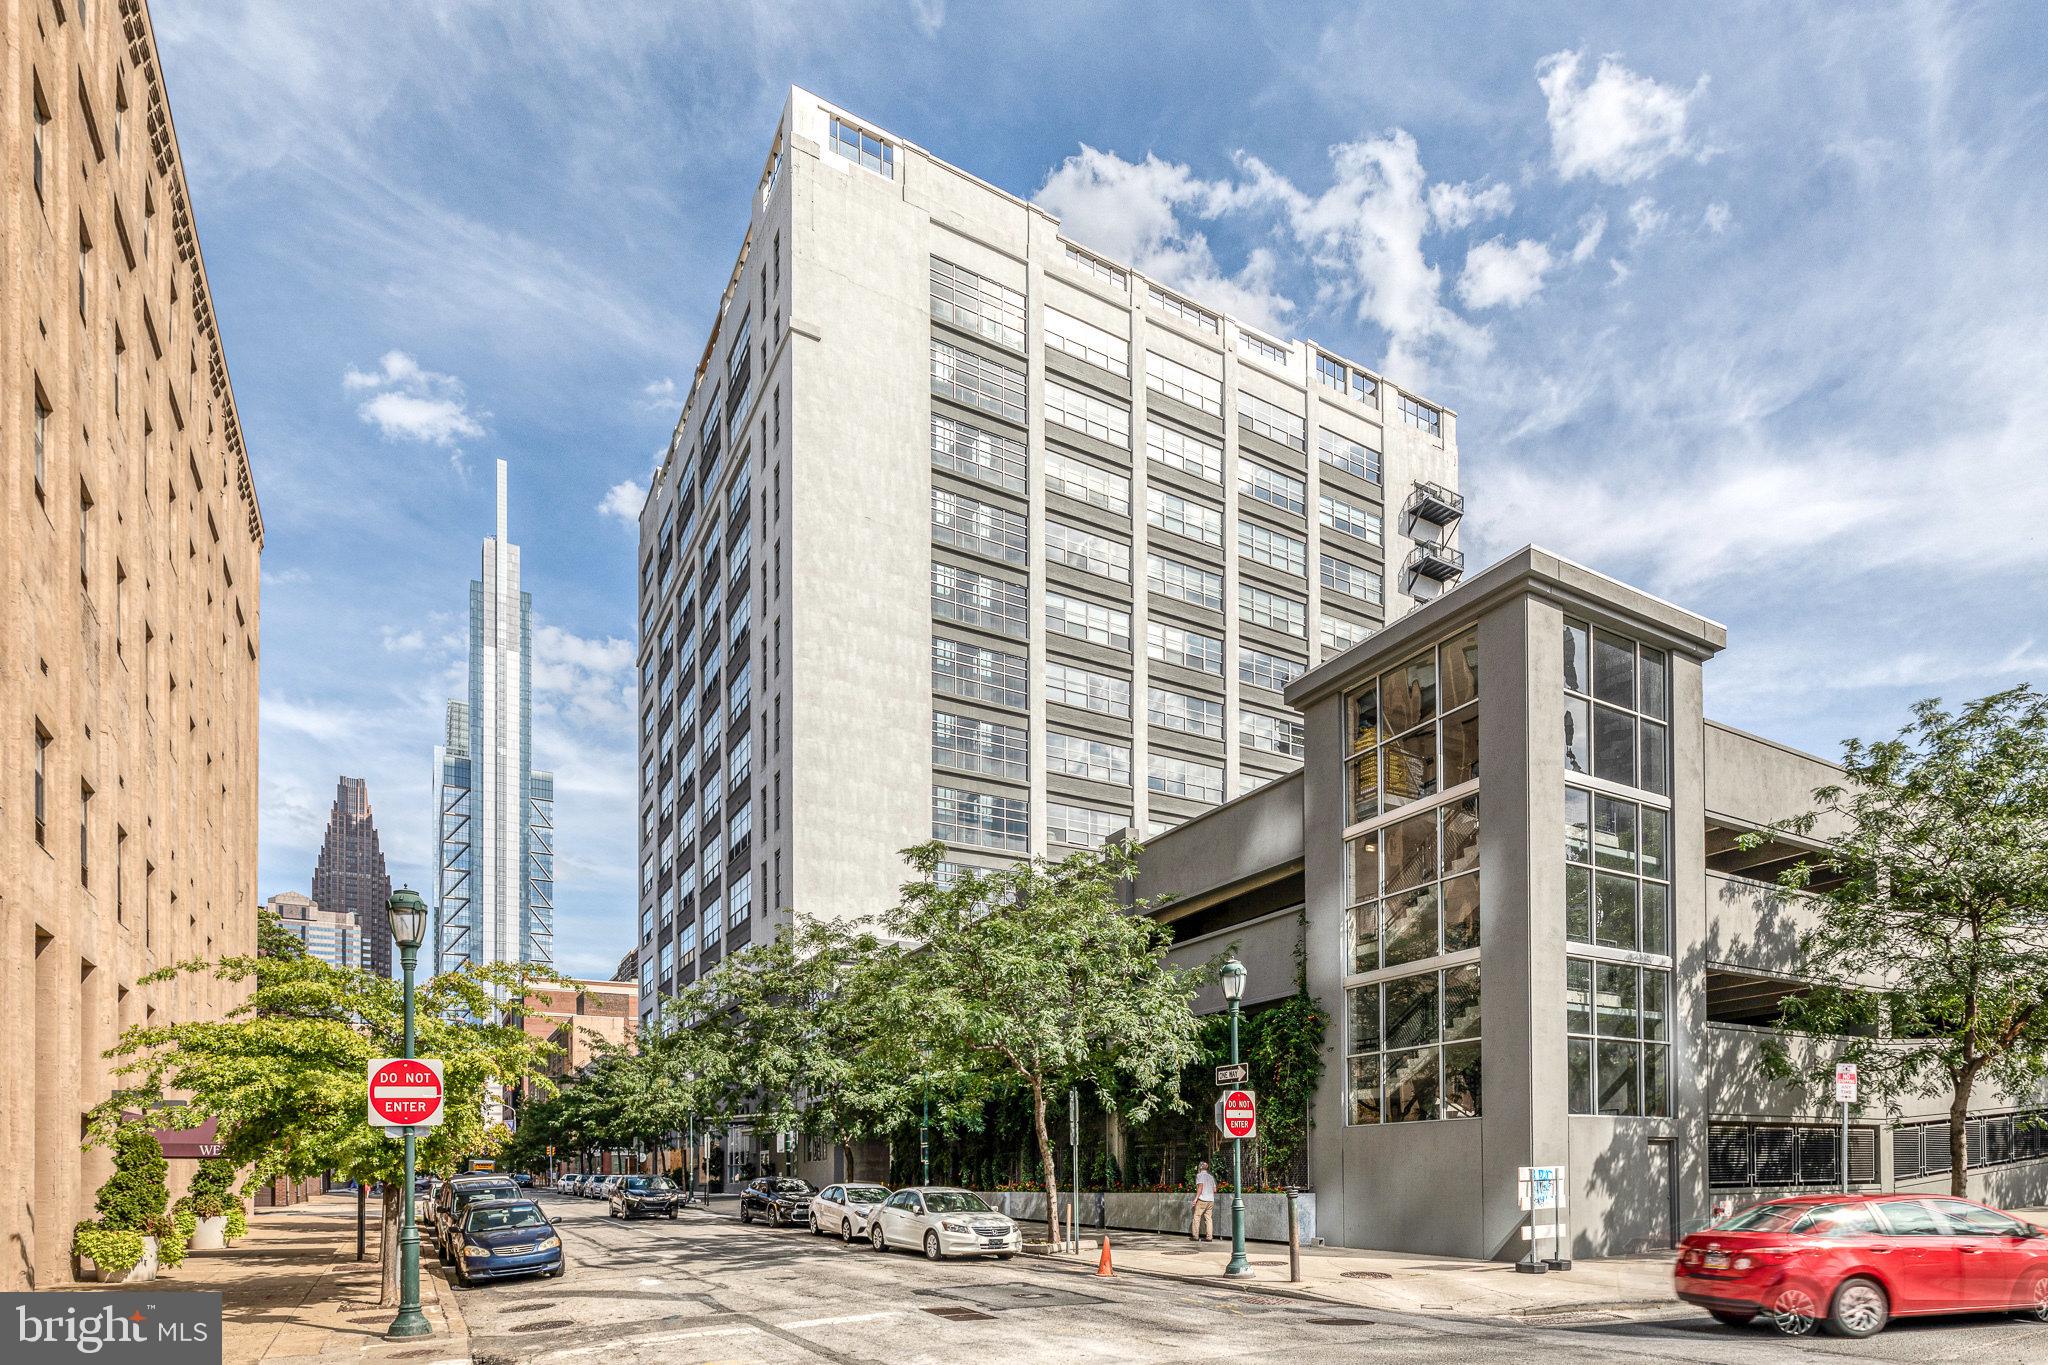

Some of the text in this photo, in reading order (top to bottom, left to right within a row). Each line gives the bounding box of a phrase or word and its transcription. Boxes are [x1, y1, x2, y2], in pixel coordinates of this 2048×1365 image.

[380, 1072, 431, 1083] DO NOT
[1219, 1070, 1238, 1080] ONE WAY
[385, 1101, 427, 1112] ENTER
[1228, 1100, 1250, 1108] DO NOT
[1230, 1120, 1249, 1129] ENTER
